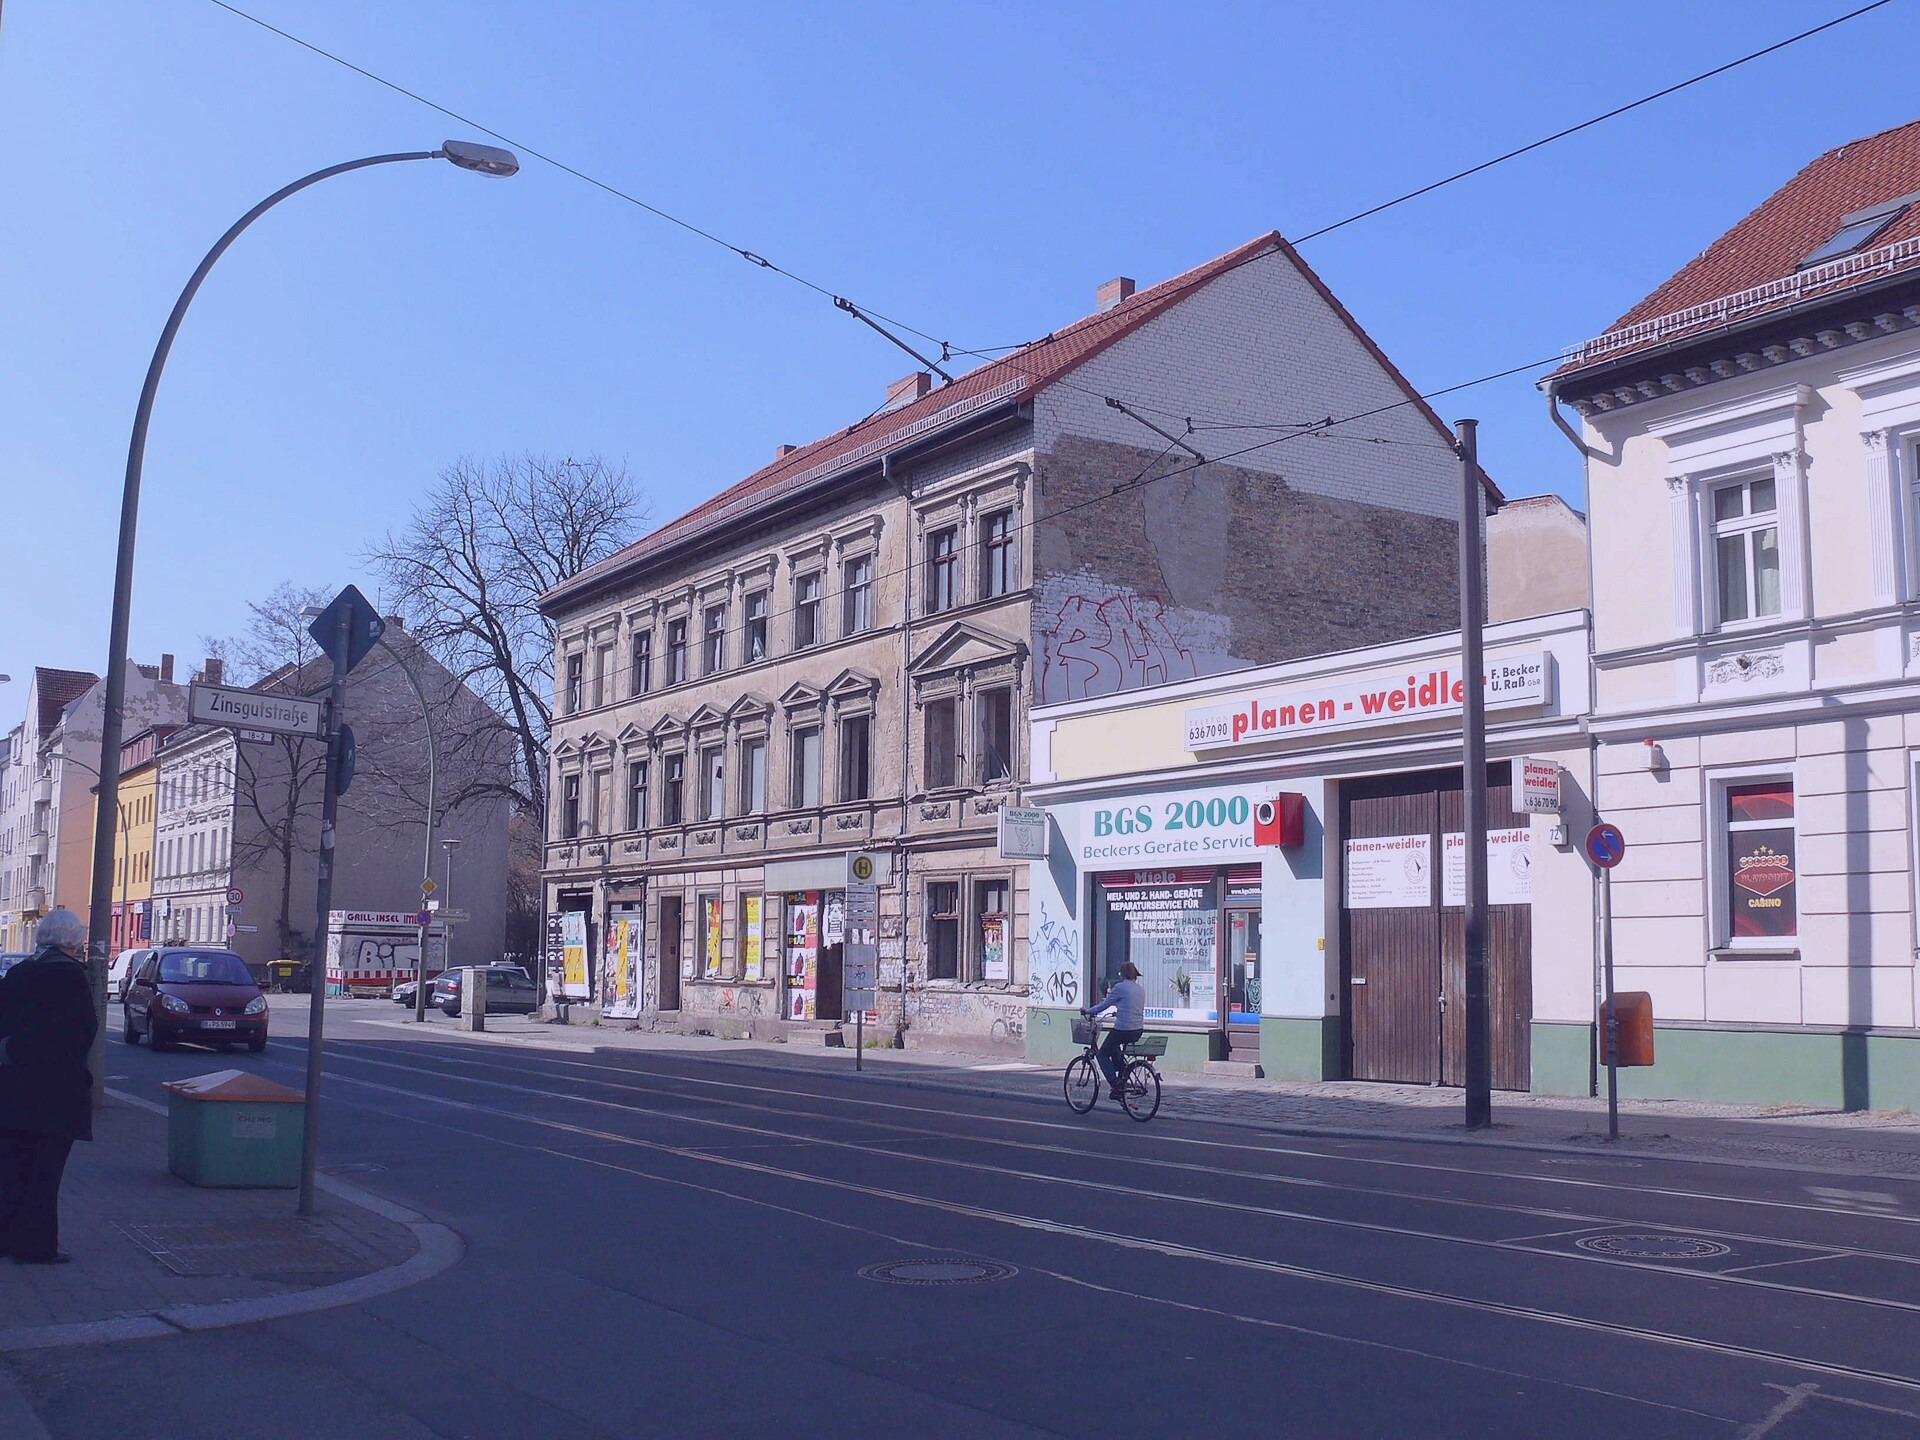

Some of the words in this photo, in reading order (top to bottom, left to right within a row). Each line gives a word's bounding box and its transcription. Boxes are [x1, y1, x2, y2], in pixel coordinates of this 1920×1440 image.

[1491, 668, 1500, 680] F.
[1503, 663, 1541, 678] Becker
[1491, 680, 1502, 692] U.
[1504, 676, 1526, 690] Raß
[210, 692, 309, 727] Zinsgutstraße
[1232, 698, 1336, 743] planen
[1359, 670, 1487, 715] weidle
[1189, 715, 1228, 727] TELEFON
[1524, 763, 1557, 776] planen-
[1524, 776, 1557, 788] weidler
[1023, 811, 1040, 819] 2000
[1094, 805, 1153, 837] BGS
[1164, 795, 1249, 831] 2000
[1549, 828, 1560, 841] 72
[1083, 843, 1140, 859] Beckers
[1144, 838, 1199, 855] Geräte
[1202, 834, 1253, 851] Servic
[1346, 837, 1427, 856] planen-weidler
[858, 861, 868, 874] H
[1133, 871, 1177, 885] Miele
[229, 892, 240, 901] 30
[1106, 892, 1124, 902] NEU-
[1124, 891, 1140, 901] UND
[1141, 891, 1148, 900] 2.
[1149, 890, 1172, 900] HAND-
[1173, 887, 1203, 898] GERÄTE
[1110, 900, 1182, 911] REPARATURSERVICE
[1183, 898, 1199, 909] FÜR
[1748, 898, 1782, 908] CASINO
[347, 912, 400, 923] GRILL-INSEL
[1124, 911, 1143, 921] ALLE
[1143, 910, 1184, 920] FABRIKATE
